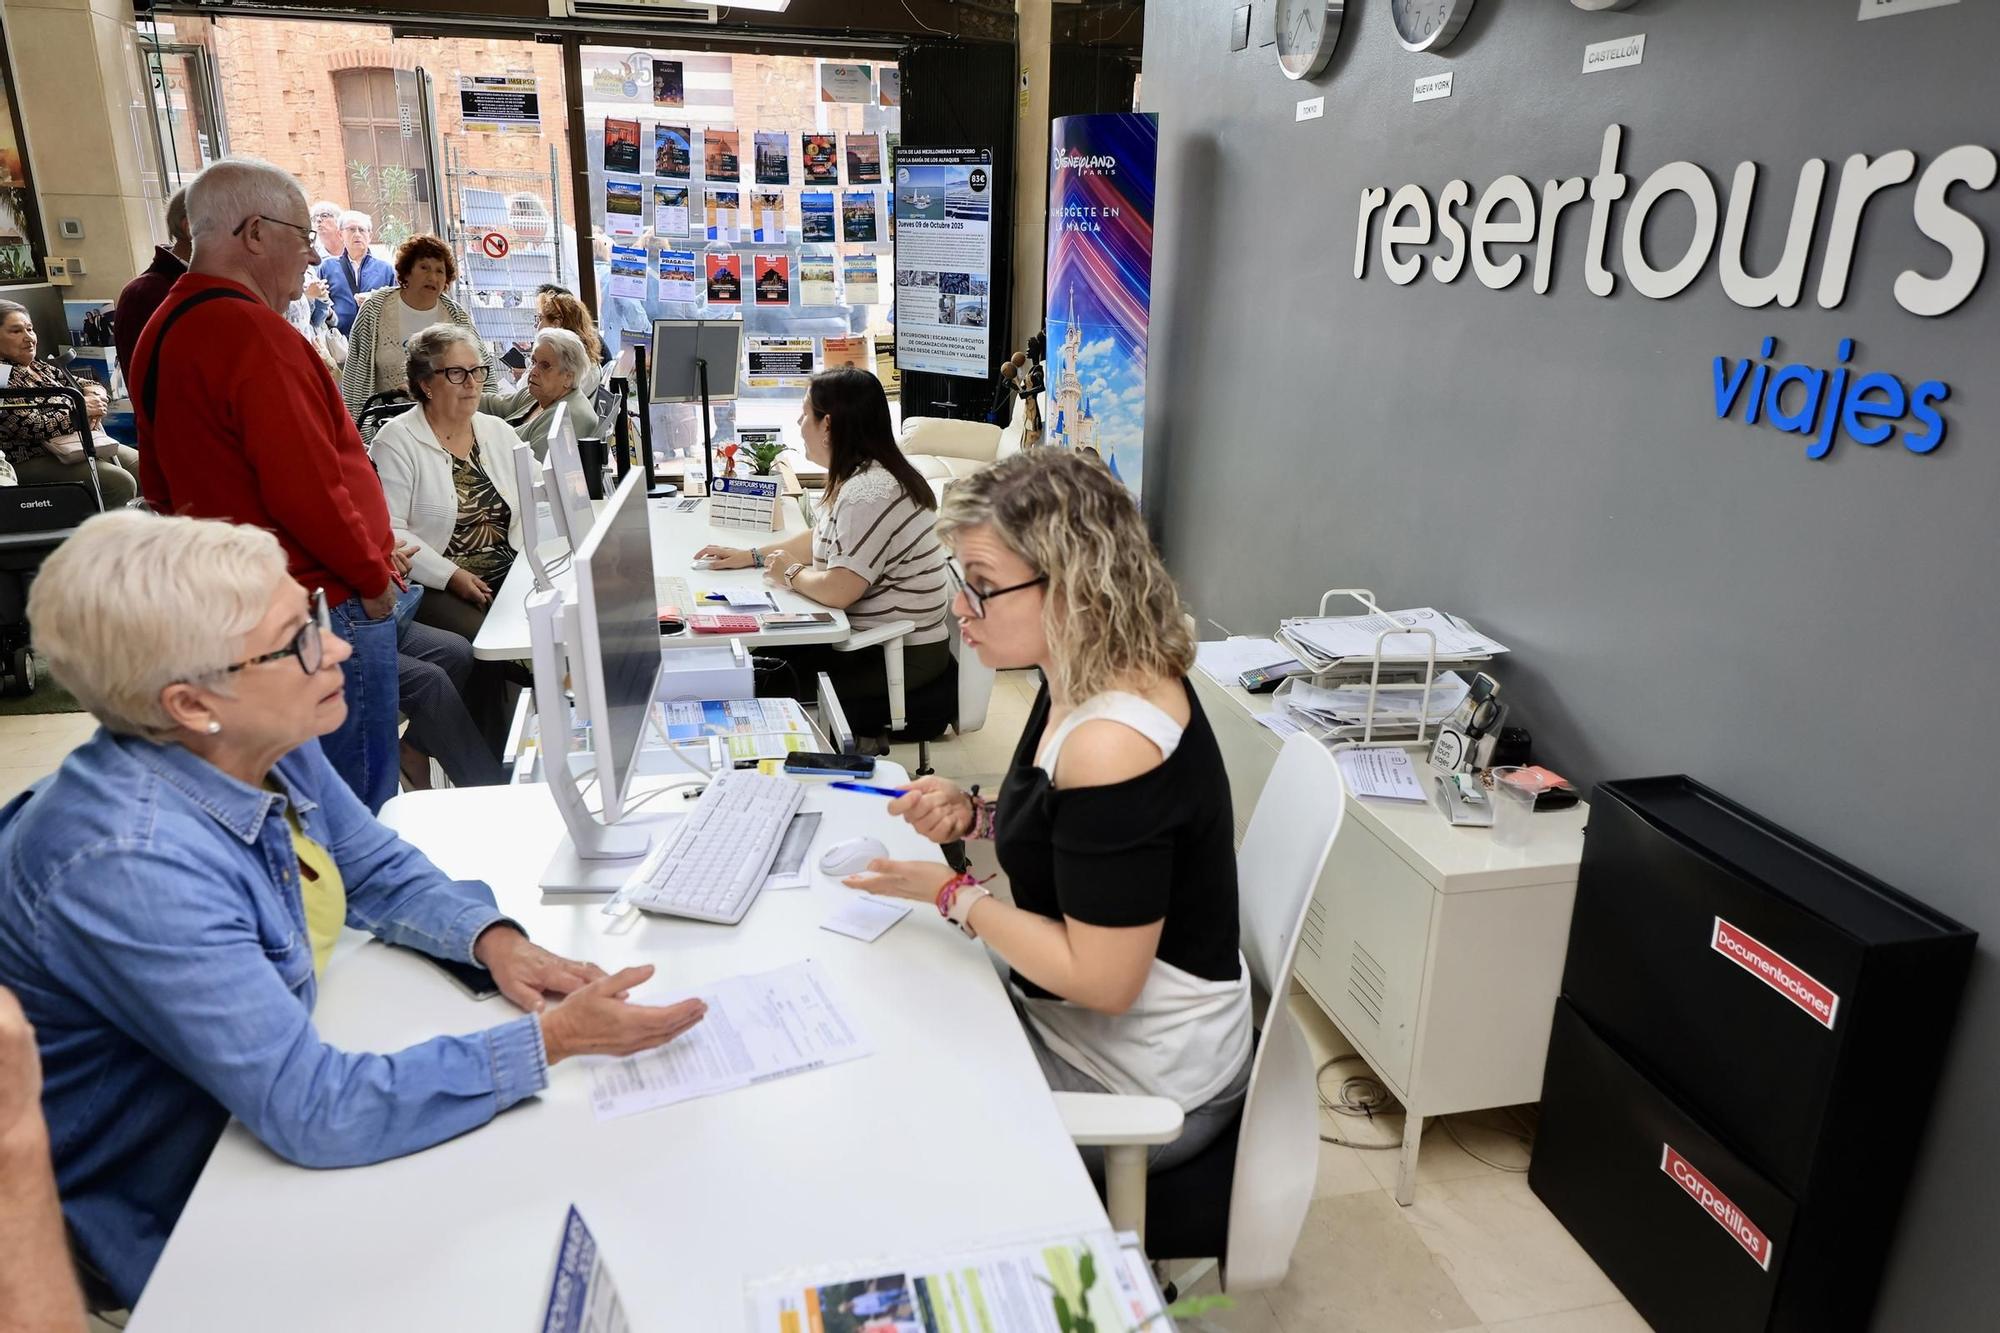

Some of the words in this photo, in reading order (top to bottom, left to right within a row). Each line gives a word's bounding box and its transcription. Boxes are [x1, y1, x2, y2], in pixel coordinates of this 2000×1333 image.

[1424, 15, 1432, 36] 6
[1588, 38, 1640, 64] CASTELLÓN
[507, 77, 536, 86] IMSERSO
[1415, 80, 1433, 95] NUEVA
[1433, 78, 1451, 91] YORK
[1302, 104, 1317, 115] TOKYO
[971, 175, 986, 183] 83€
[1103, 206, 1120, 218] EN
[951, 222, 964, 230] 2025
[1055, 222, 1063, 232] LA
[1066, 221, 1101, 232] MAGIA
[1353, 124, 1998, 317] resertours
[900, 331, 930, 340] EXCURSIONES
[960, 337, 985, 345] CIRCUITOS
[914, 339, 949, 348] ORGANIZACIÓN
[930, 349, 956, 357] CASTELLÓN
[960, 351, 987, 360] VILLARREAL
[1712, 336, 1952, 461] viajes
[728, 480, 759, 489] RESERTOURS
[20, 499, 53, 509] carlett.
[1439, 739, 1454, 750] reser
[1436, 746, 1450, 758] tours
[1434, 755, 1450, 768] viajes
[1717, 930, 1831, 1017] Documentaciones
[1672, 1160, 1760, 1253] Carpetillas
